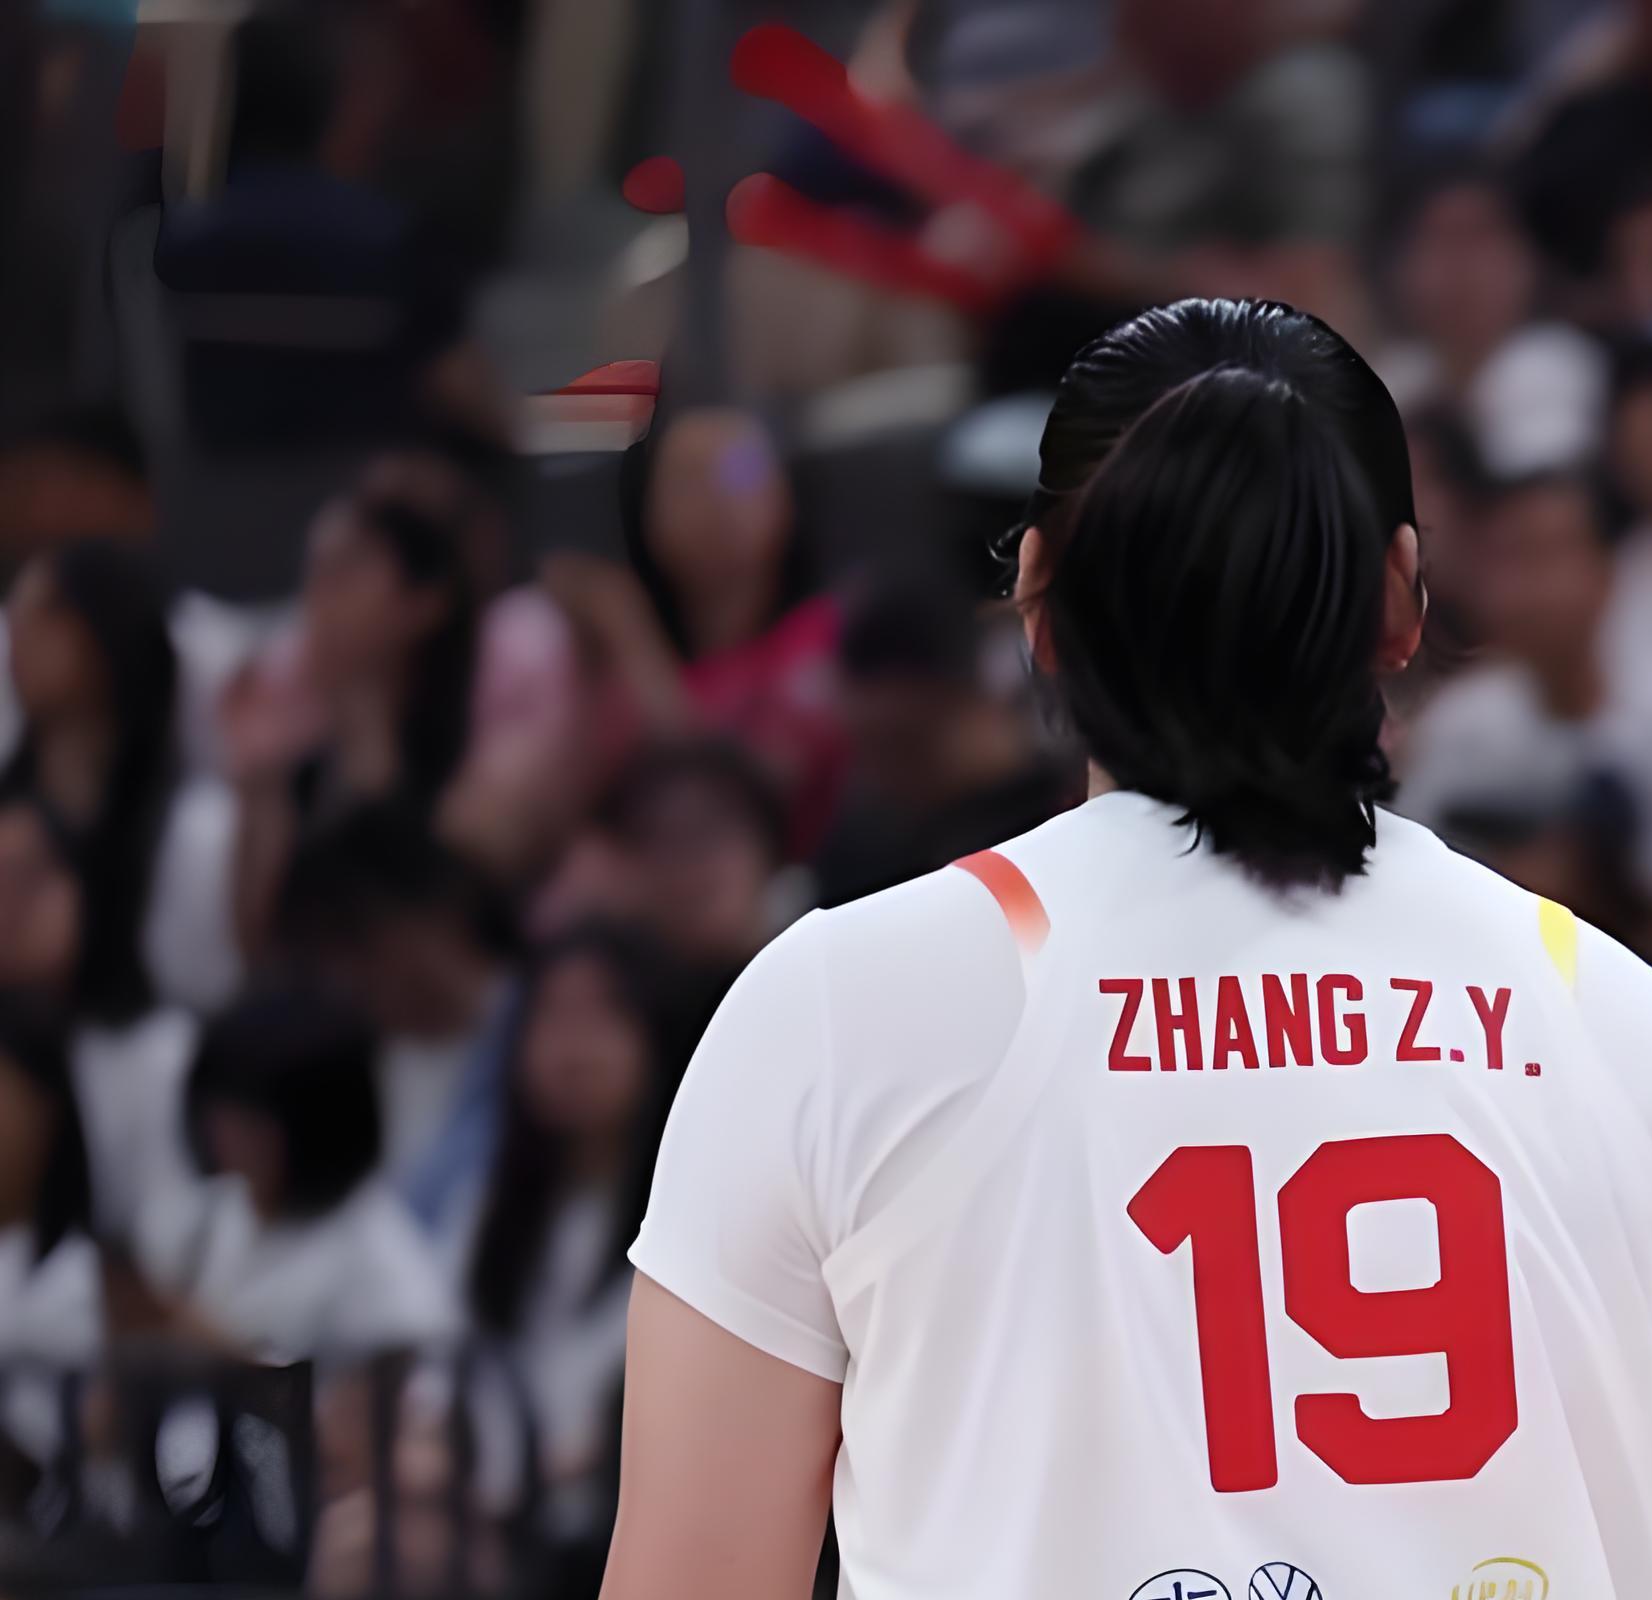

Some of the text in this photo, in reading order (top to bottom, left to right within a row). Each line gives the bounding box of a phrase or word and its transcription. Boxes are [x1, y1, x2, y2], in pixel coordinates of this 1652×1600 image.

[1099, 973, 1540, 1076] ZHANG Z.Y.
[1127, 1134, 1518, 1493] 19
